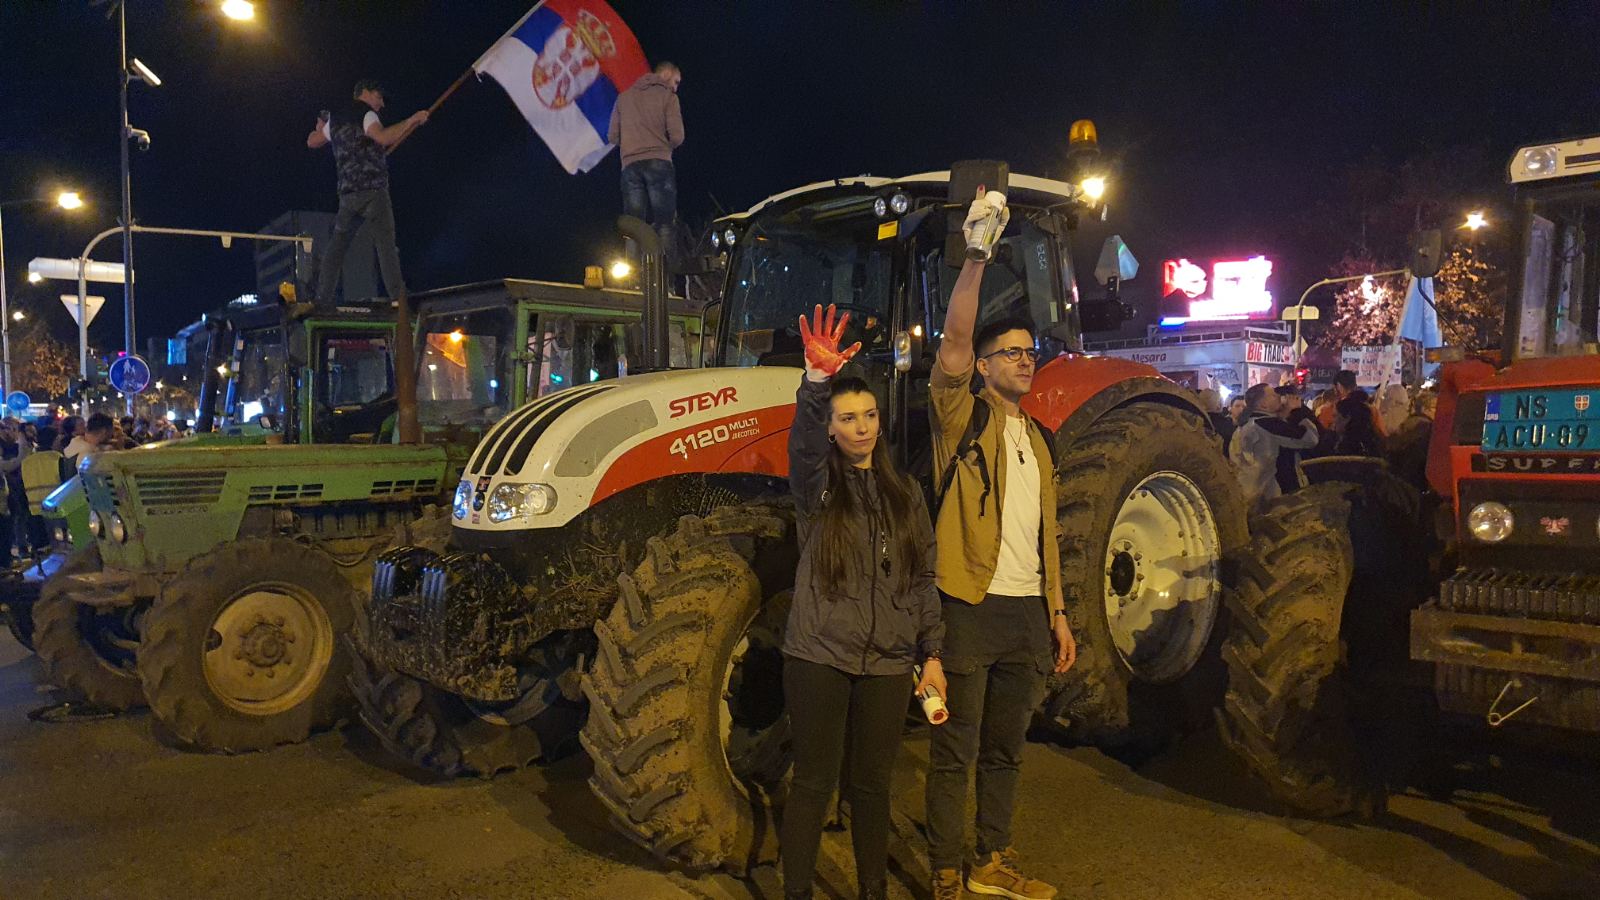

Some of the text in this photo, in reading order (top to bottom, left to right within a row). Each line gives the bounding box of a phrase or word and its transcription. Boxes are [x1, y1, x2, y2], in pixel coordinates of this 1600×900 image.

[1247, 342, 1263, 361] BIG
[669, 386, 738, 419] STEYR
[1517, 395, 1548, 419] NS
[729, 417, 759, 431] MULTI
[669, 425, 730, 460] 4120
